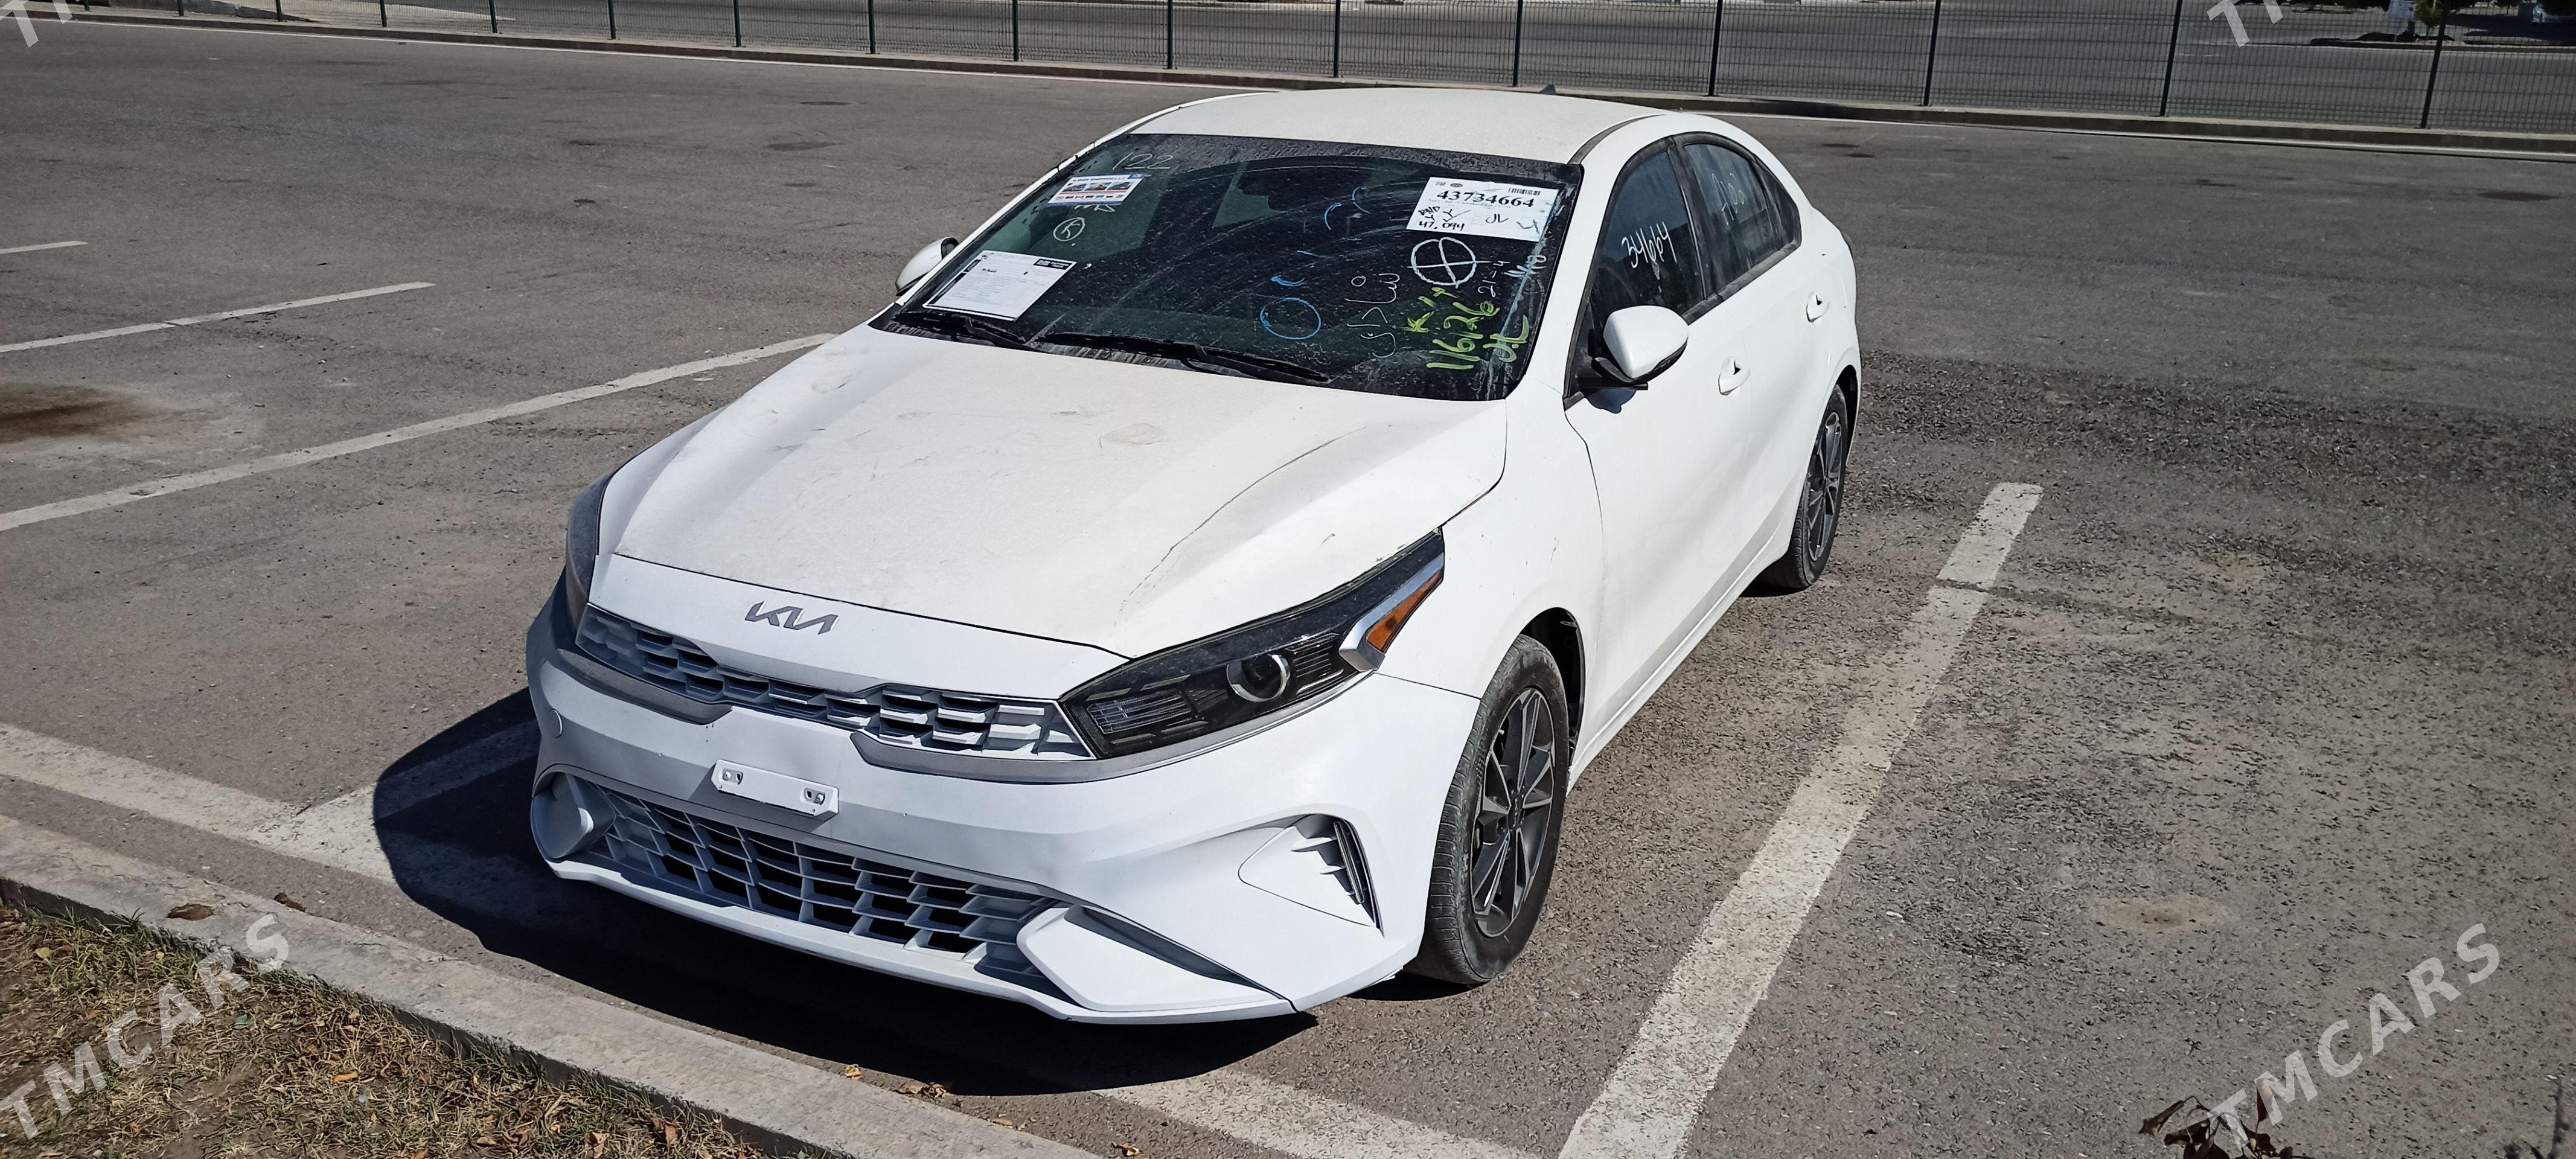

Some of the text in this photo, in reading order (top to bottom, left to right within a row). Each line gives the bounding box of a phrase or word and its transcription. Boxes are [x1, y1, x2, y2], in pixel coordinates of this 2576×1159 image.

[1112, 152, 1174, 170] 122
[1436, 190, 1535, 208] 43734664
[745, 600, 840, 635] KIA
